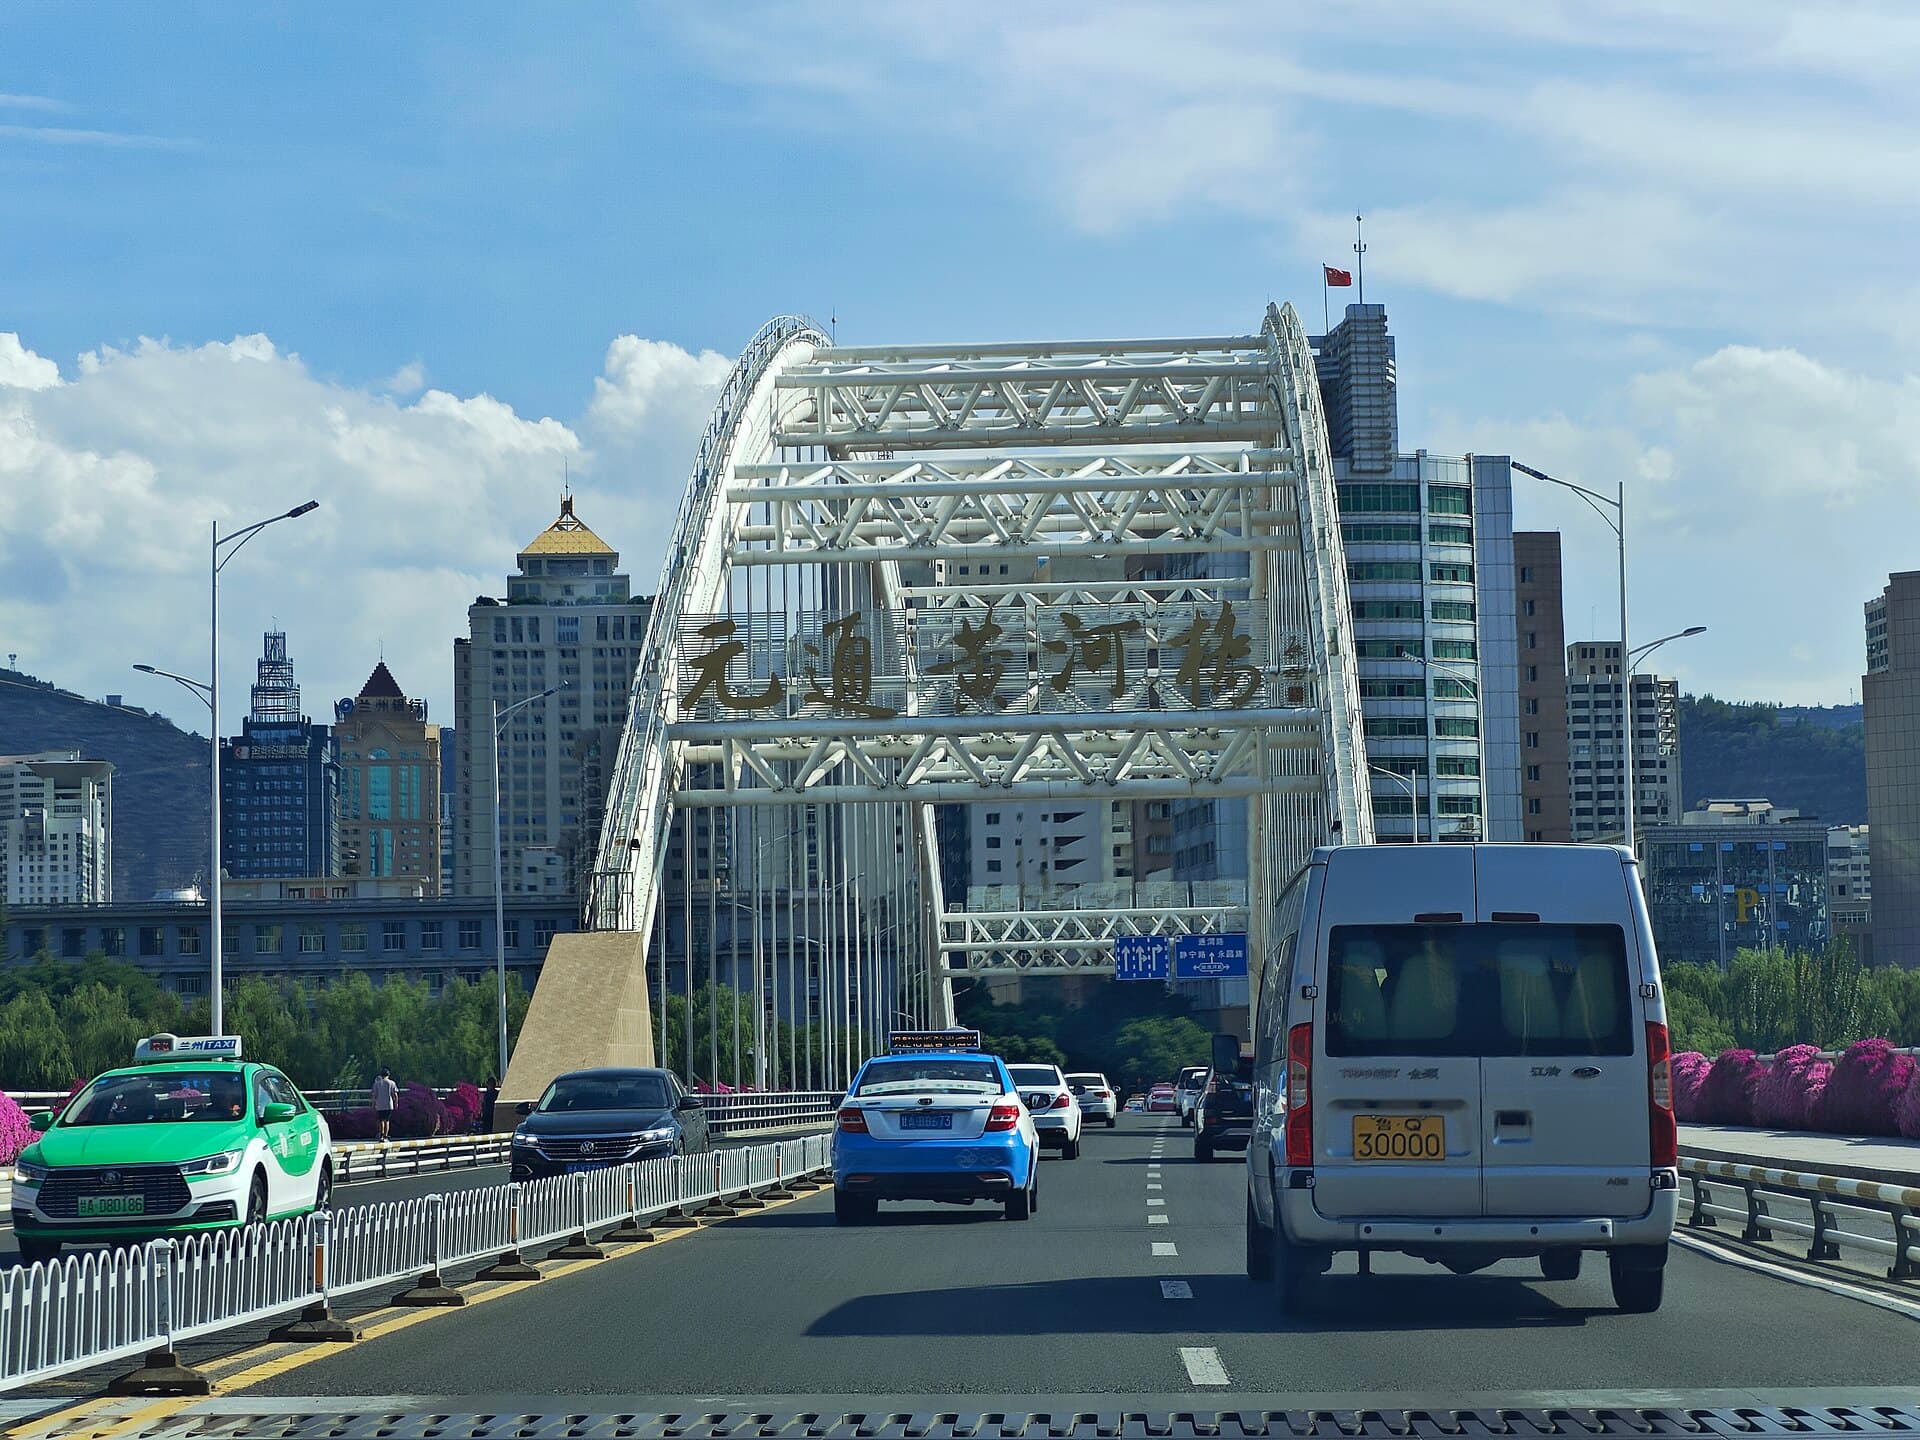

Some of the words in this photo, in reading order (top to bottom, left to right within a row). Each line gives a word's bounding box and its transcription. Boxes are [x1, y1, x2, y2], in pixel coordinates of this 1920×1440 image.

[1735, 888, 1759, 922] P
[177, 1041, 203, 1051] 兰州
[207, 1040, 235, 1049] TAXI
[1358, 1133, 1440, 1157] 30000
